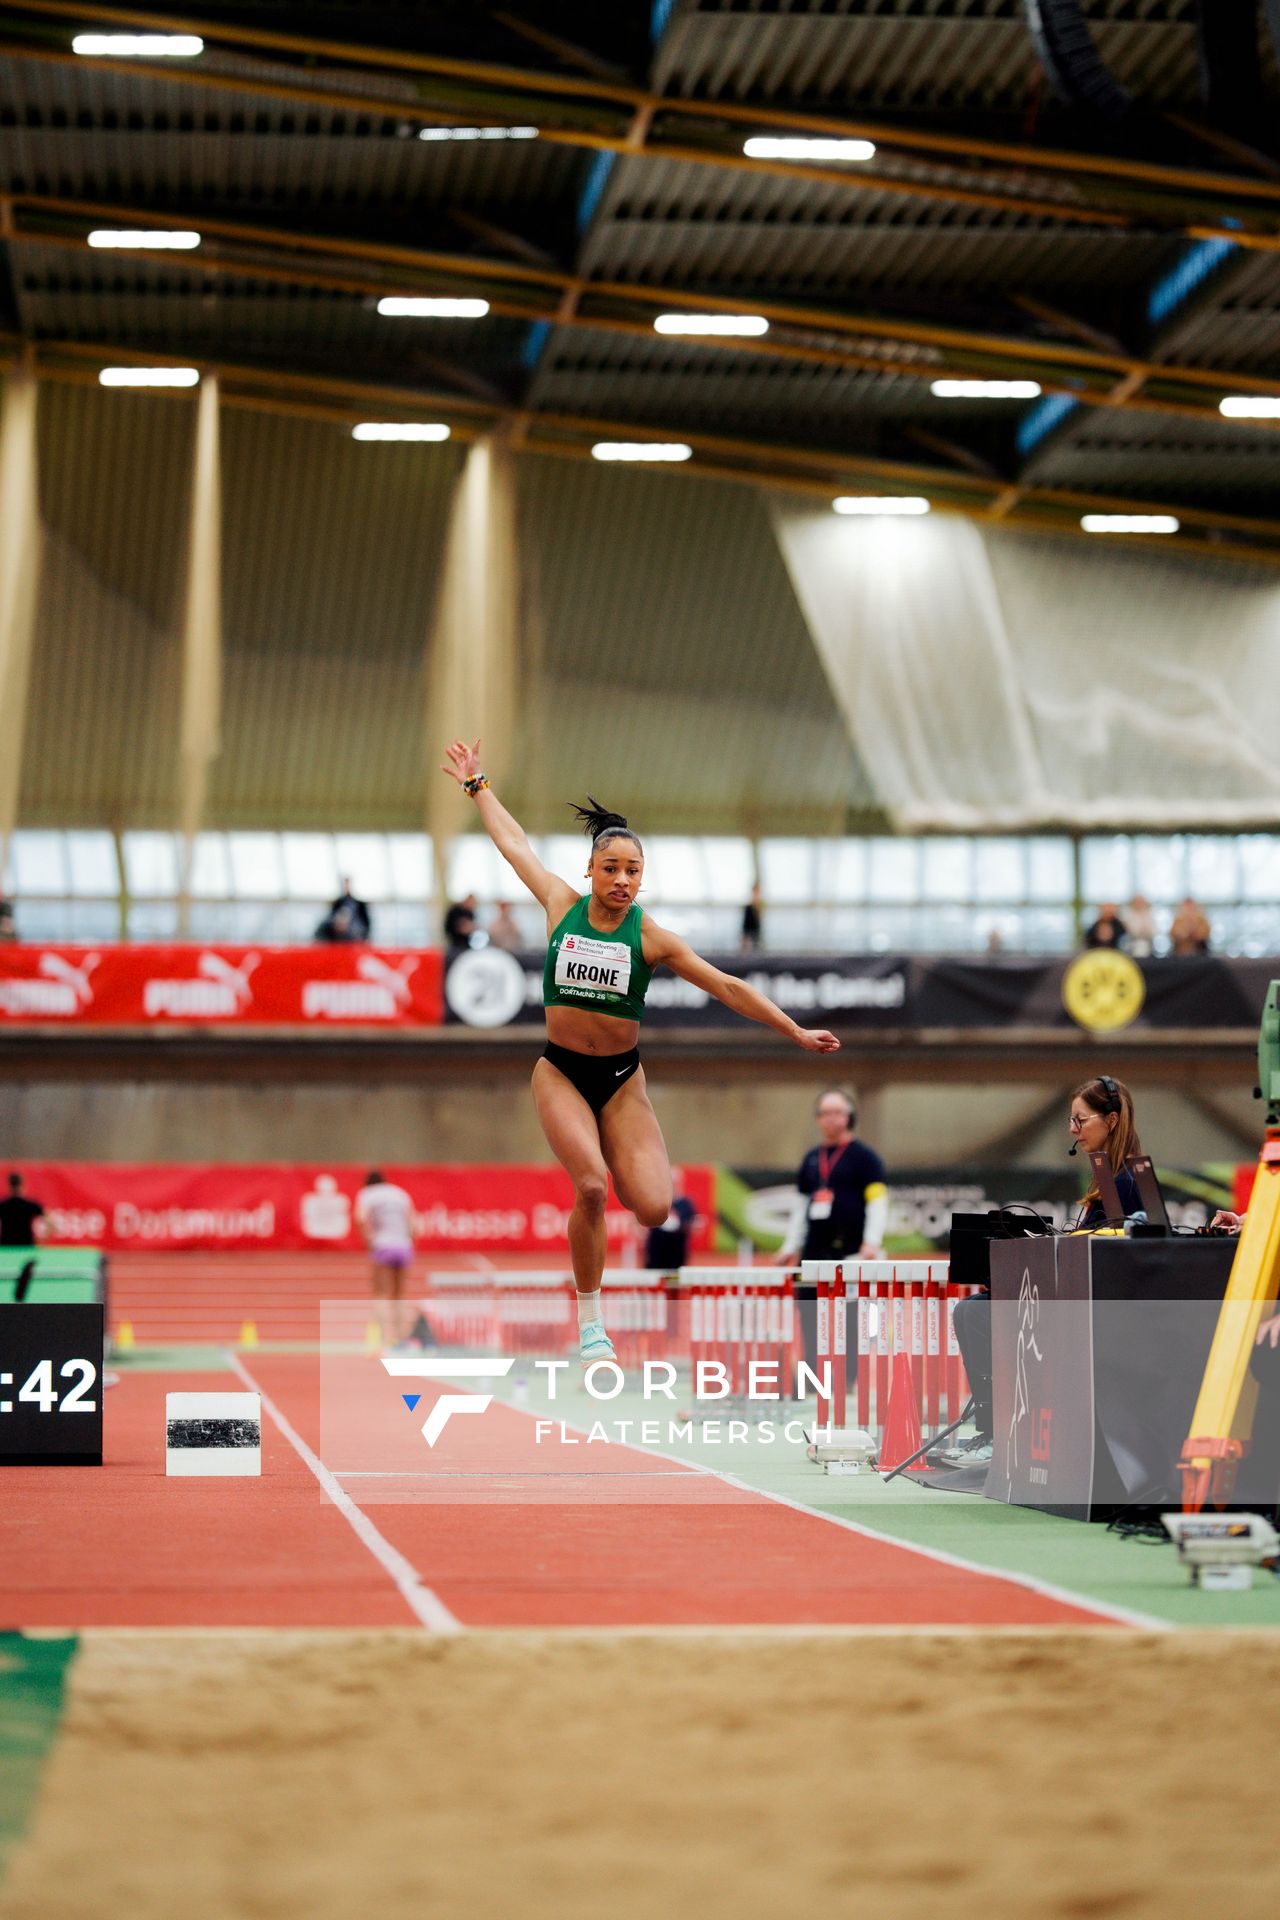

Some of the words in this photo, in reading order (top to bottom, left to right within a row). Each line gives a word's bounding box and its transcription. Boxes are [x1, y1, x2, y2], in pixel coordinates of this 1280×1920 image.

[577, 945, 604, 955] Dortmund
[578, 939, 596, 948] Indoor
[597, 943, 618, 952] Meeting
[566, 961, 620, 987] KRONE
[560, 988, 596, 998] DORTMUND
